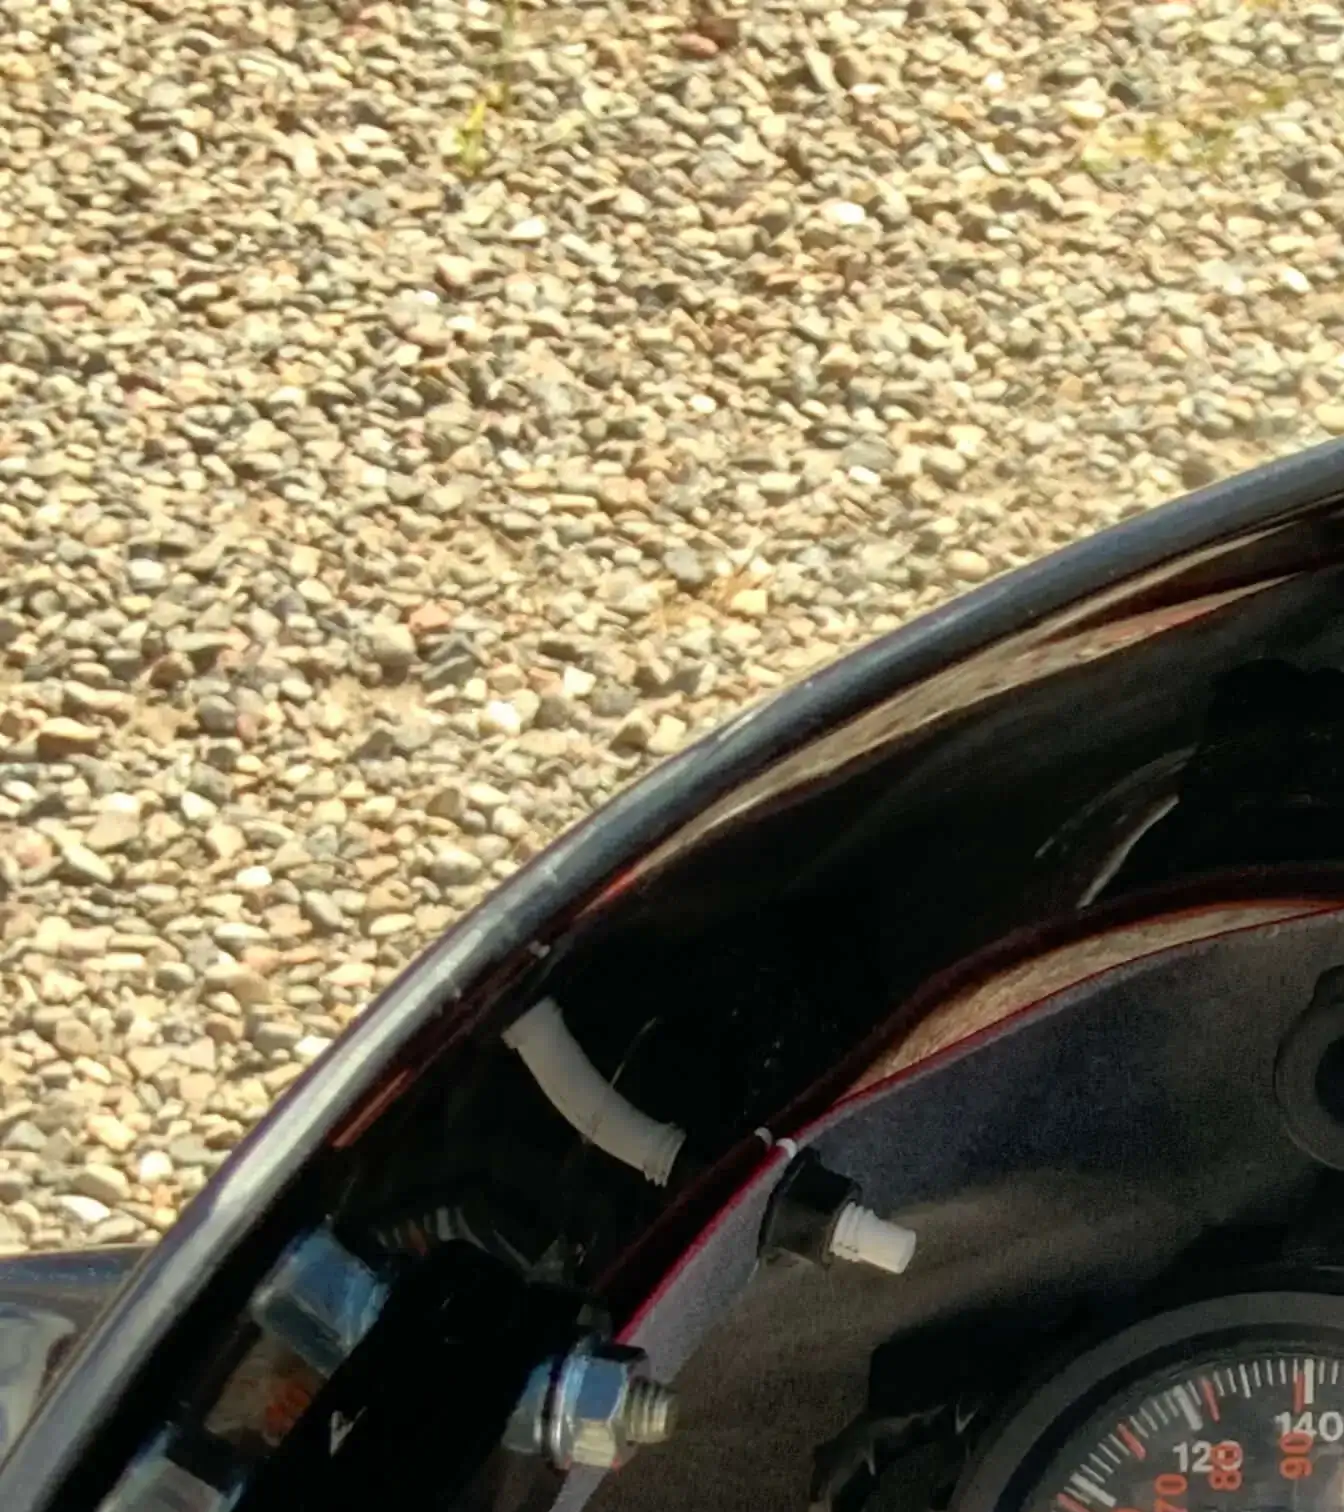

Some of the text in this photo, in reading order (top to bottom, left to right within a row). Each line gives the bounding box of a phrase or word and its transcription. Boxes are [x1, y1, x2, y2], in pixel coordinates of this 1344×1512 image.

[1275, 1410, 1344, 1443] 140
[1173, 1440, 1243, 1473] 120
[1279, 1430, 1313, 1479] 90
